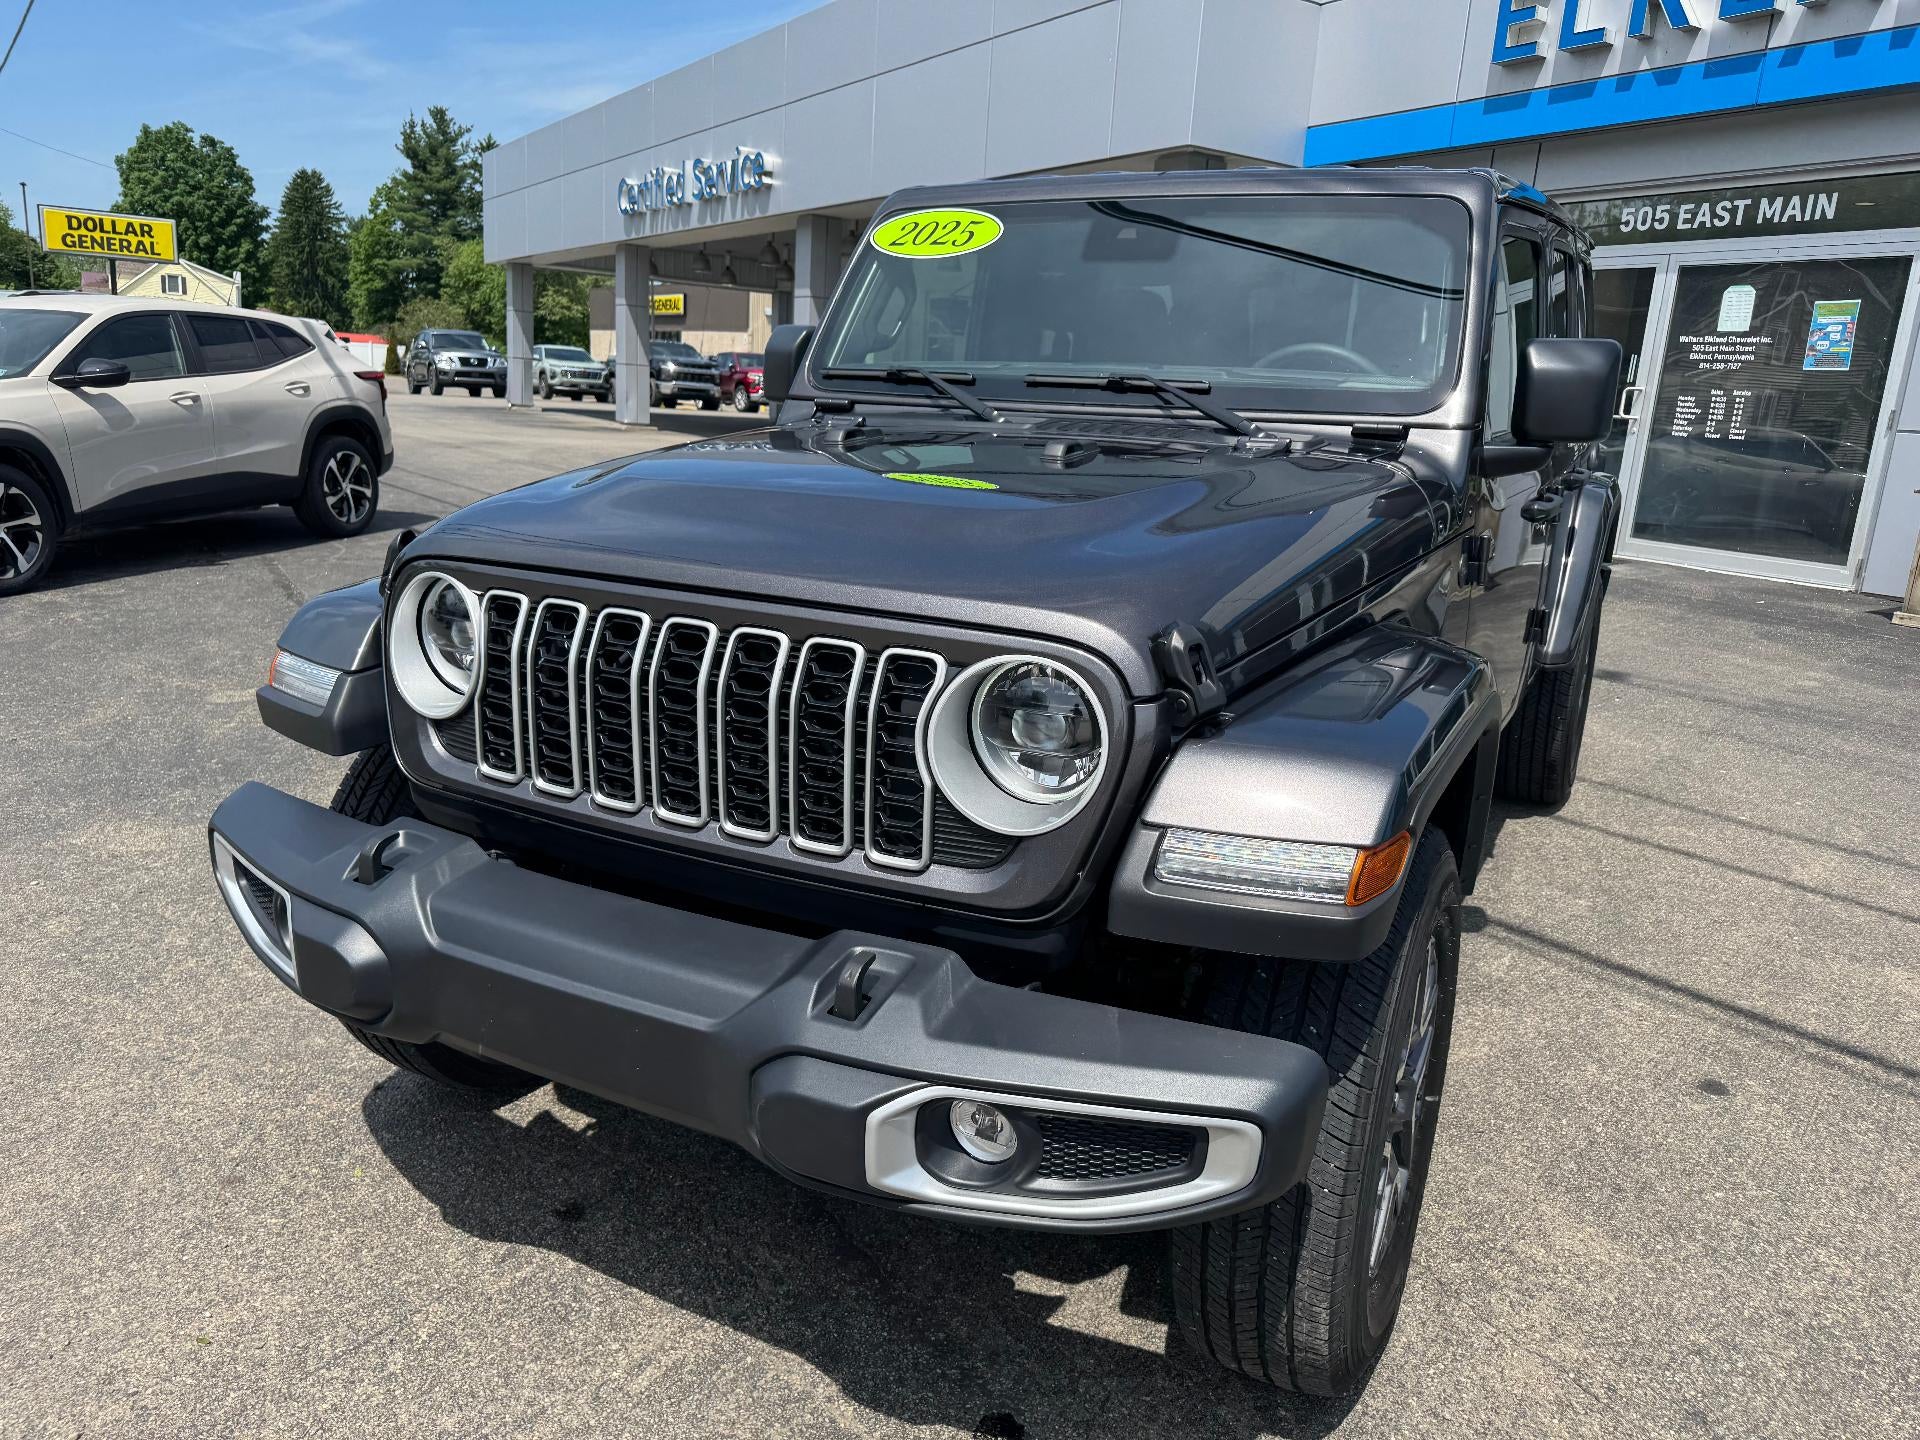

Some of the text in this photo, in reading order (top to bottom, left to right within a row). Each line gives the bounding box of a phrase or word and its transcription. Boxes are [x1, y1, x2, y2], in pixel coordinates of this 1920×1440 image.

[618, 146, 768, 216] Certified Service
[1619, 192, 1839, 232] 505 EAST MAIN
[65, 214, 155, 238] DOLLAR
[888, 220, 985, 247] 2025
[61, 232, 162, 256] GENERAL
[655, 297, 681, 312] GENERAL
[1679, 335, 1703, 343] Walters
[1704, 335, 1727, 343] Elkland
[1728, 335, 1760, 343] Chevrolet
[1692, 344, 1705, 352] 505
[1705, 344, 1719, 352] East
[1719, 344, 1734, 352] Main
[1689, 352, 1755, 362] Elkland, Pennsylvania
[1698, 362, 1742, 370] 814-258-7127
[1673, 418, 1689, 426] Friday
[1672, 424, 1693, 432] Saturday
[1671, 430, 1689, 438] Sunday
